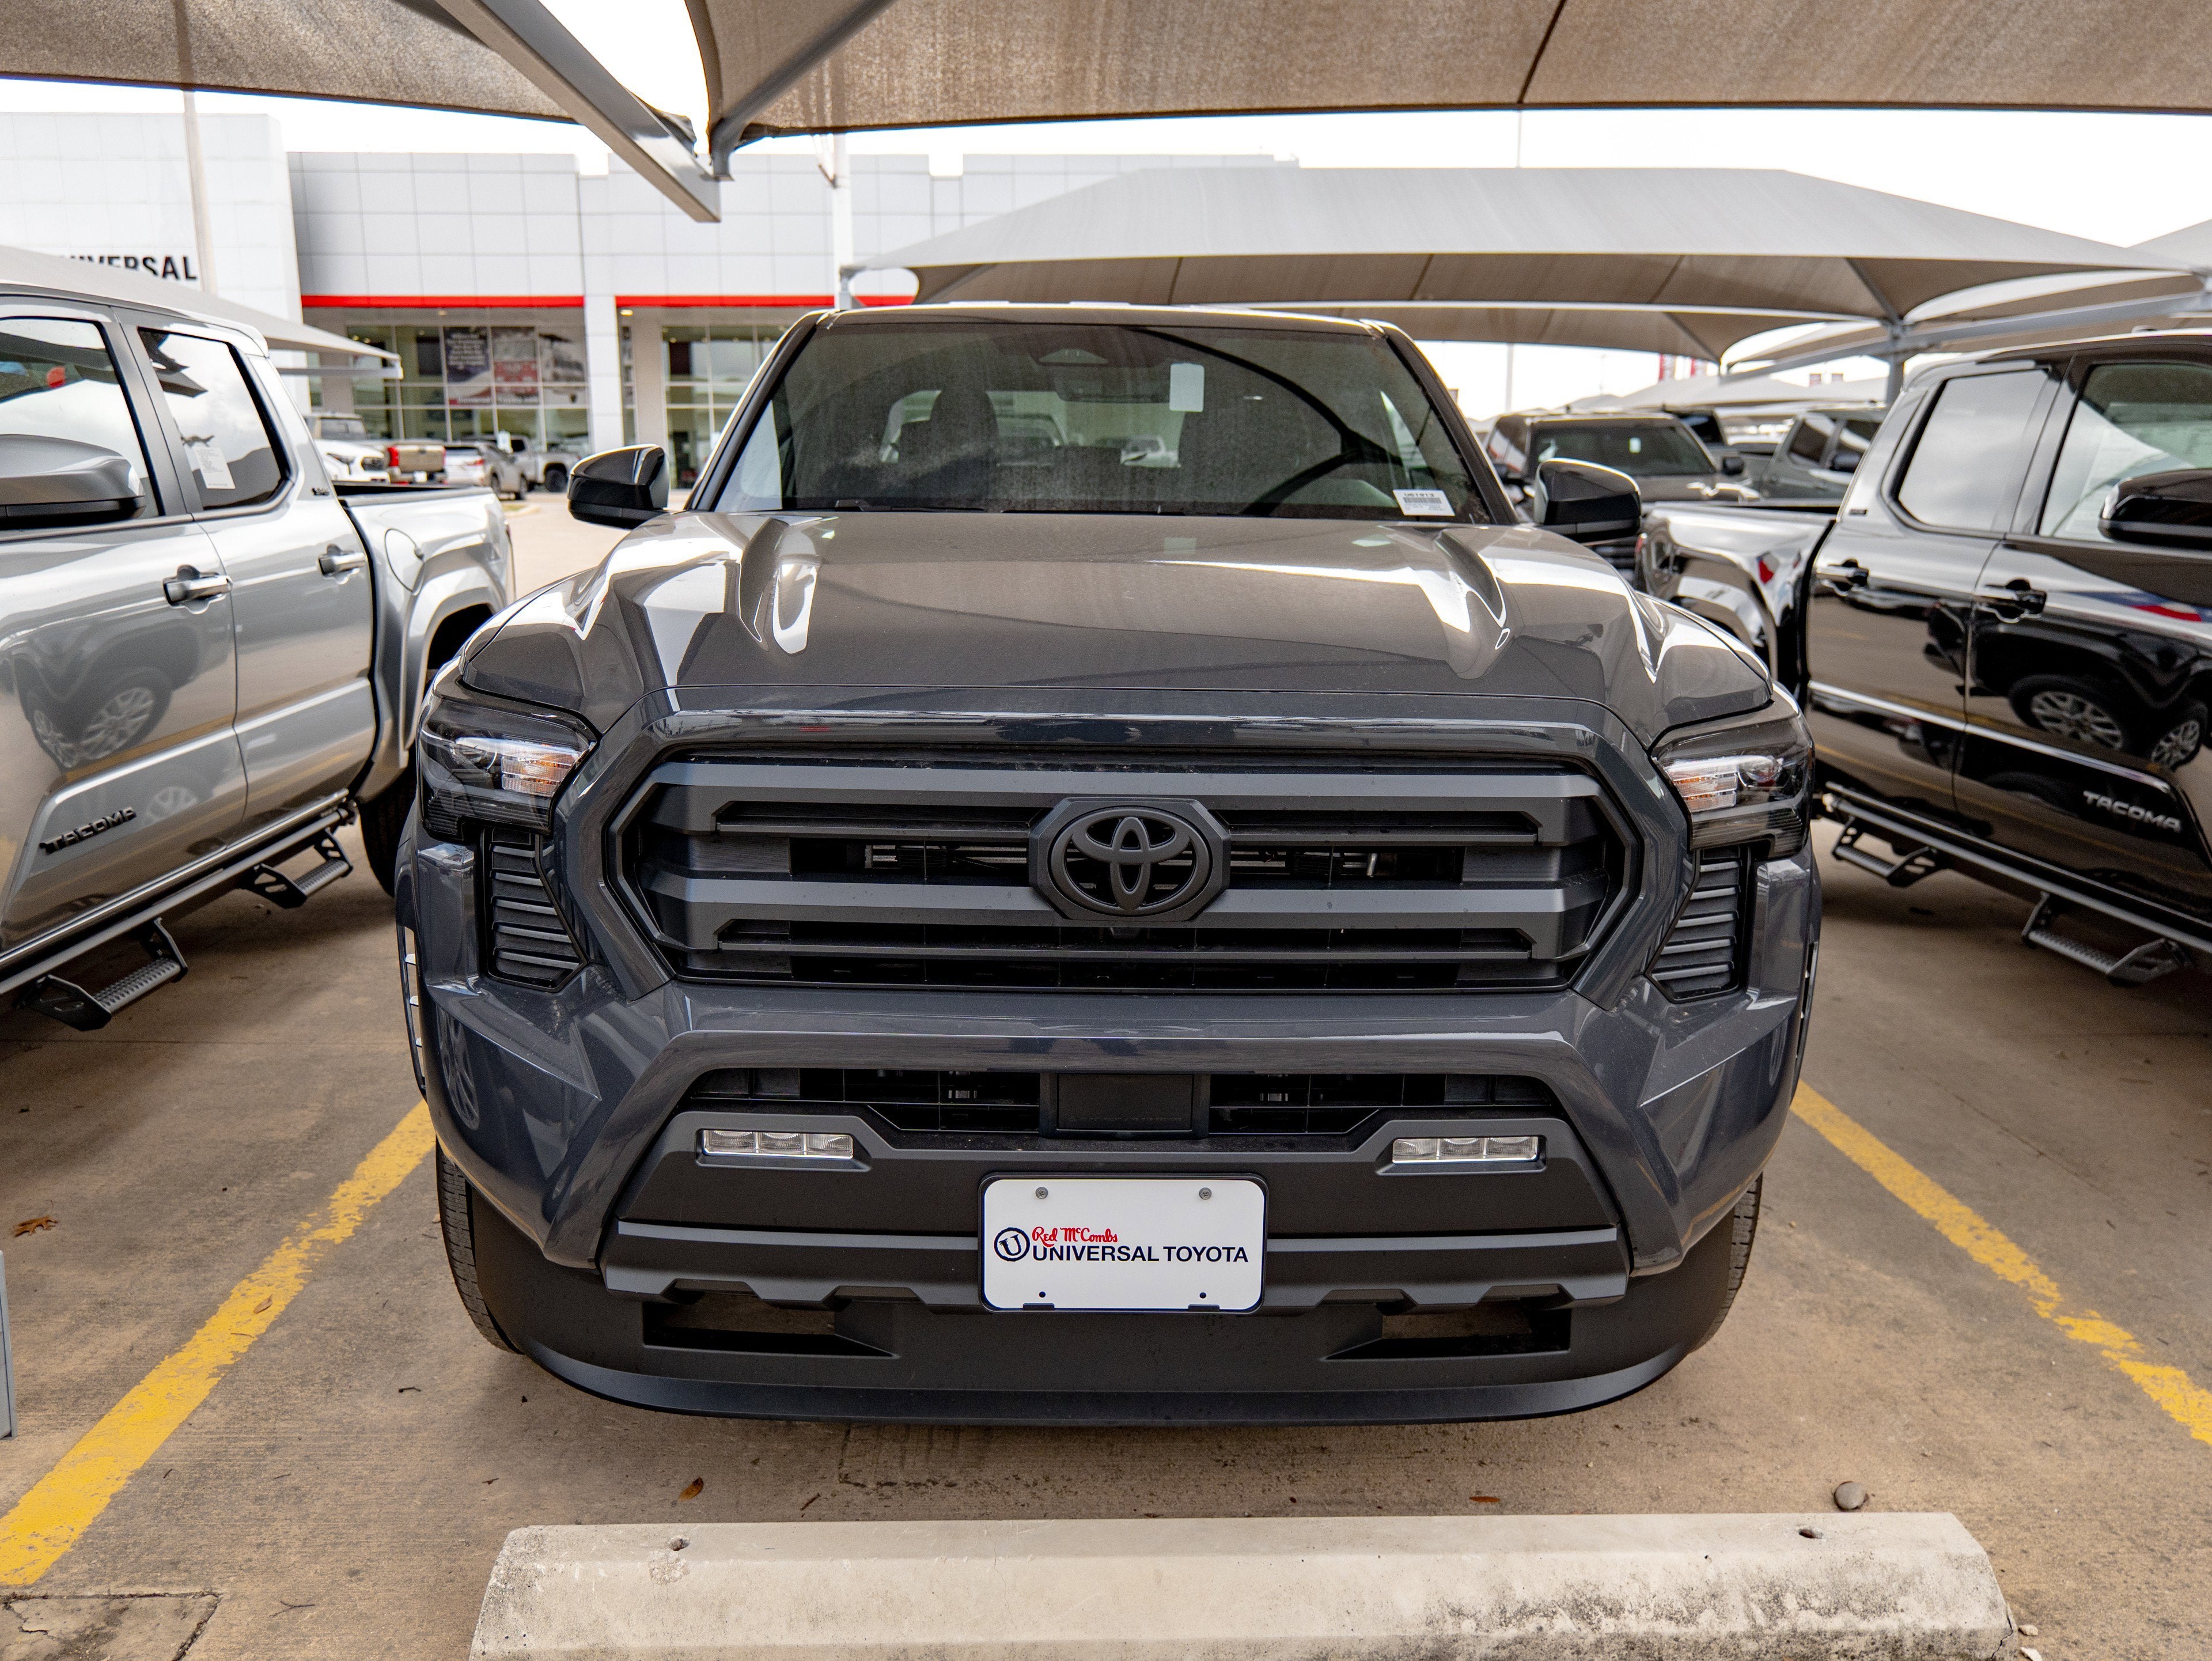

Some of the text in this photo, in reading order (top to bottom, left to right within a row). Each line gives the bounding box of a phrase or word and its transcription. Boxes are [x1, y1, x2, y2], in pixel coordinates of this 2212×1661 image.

[69, 255, 197, 280] ERSAL
[2083, 790, 2181, 833] TACOMA
[39, 807, 137, 855] TACOMA
[1032, 1226, 1118, 1247] Red McCombs
[1033, 1245, 1249, 1262] UNIVERSAL TOYOTA
